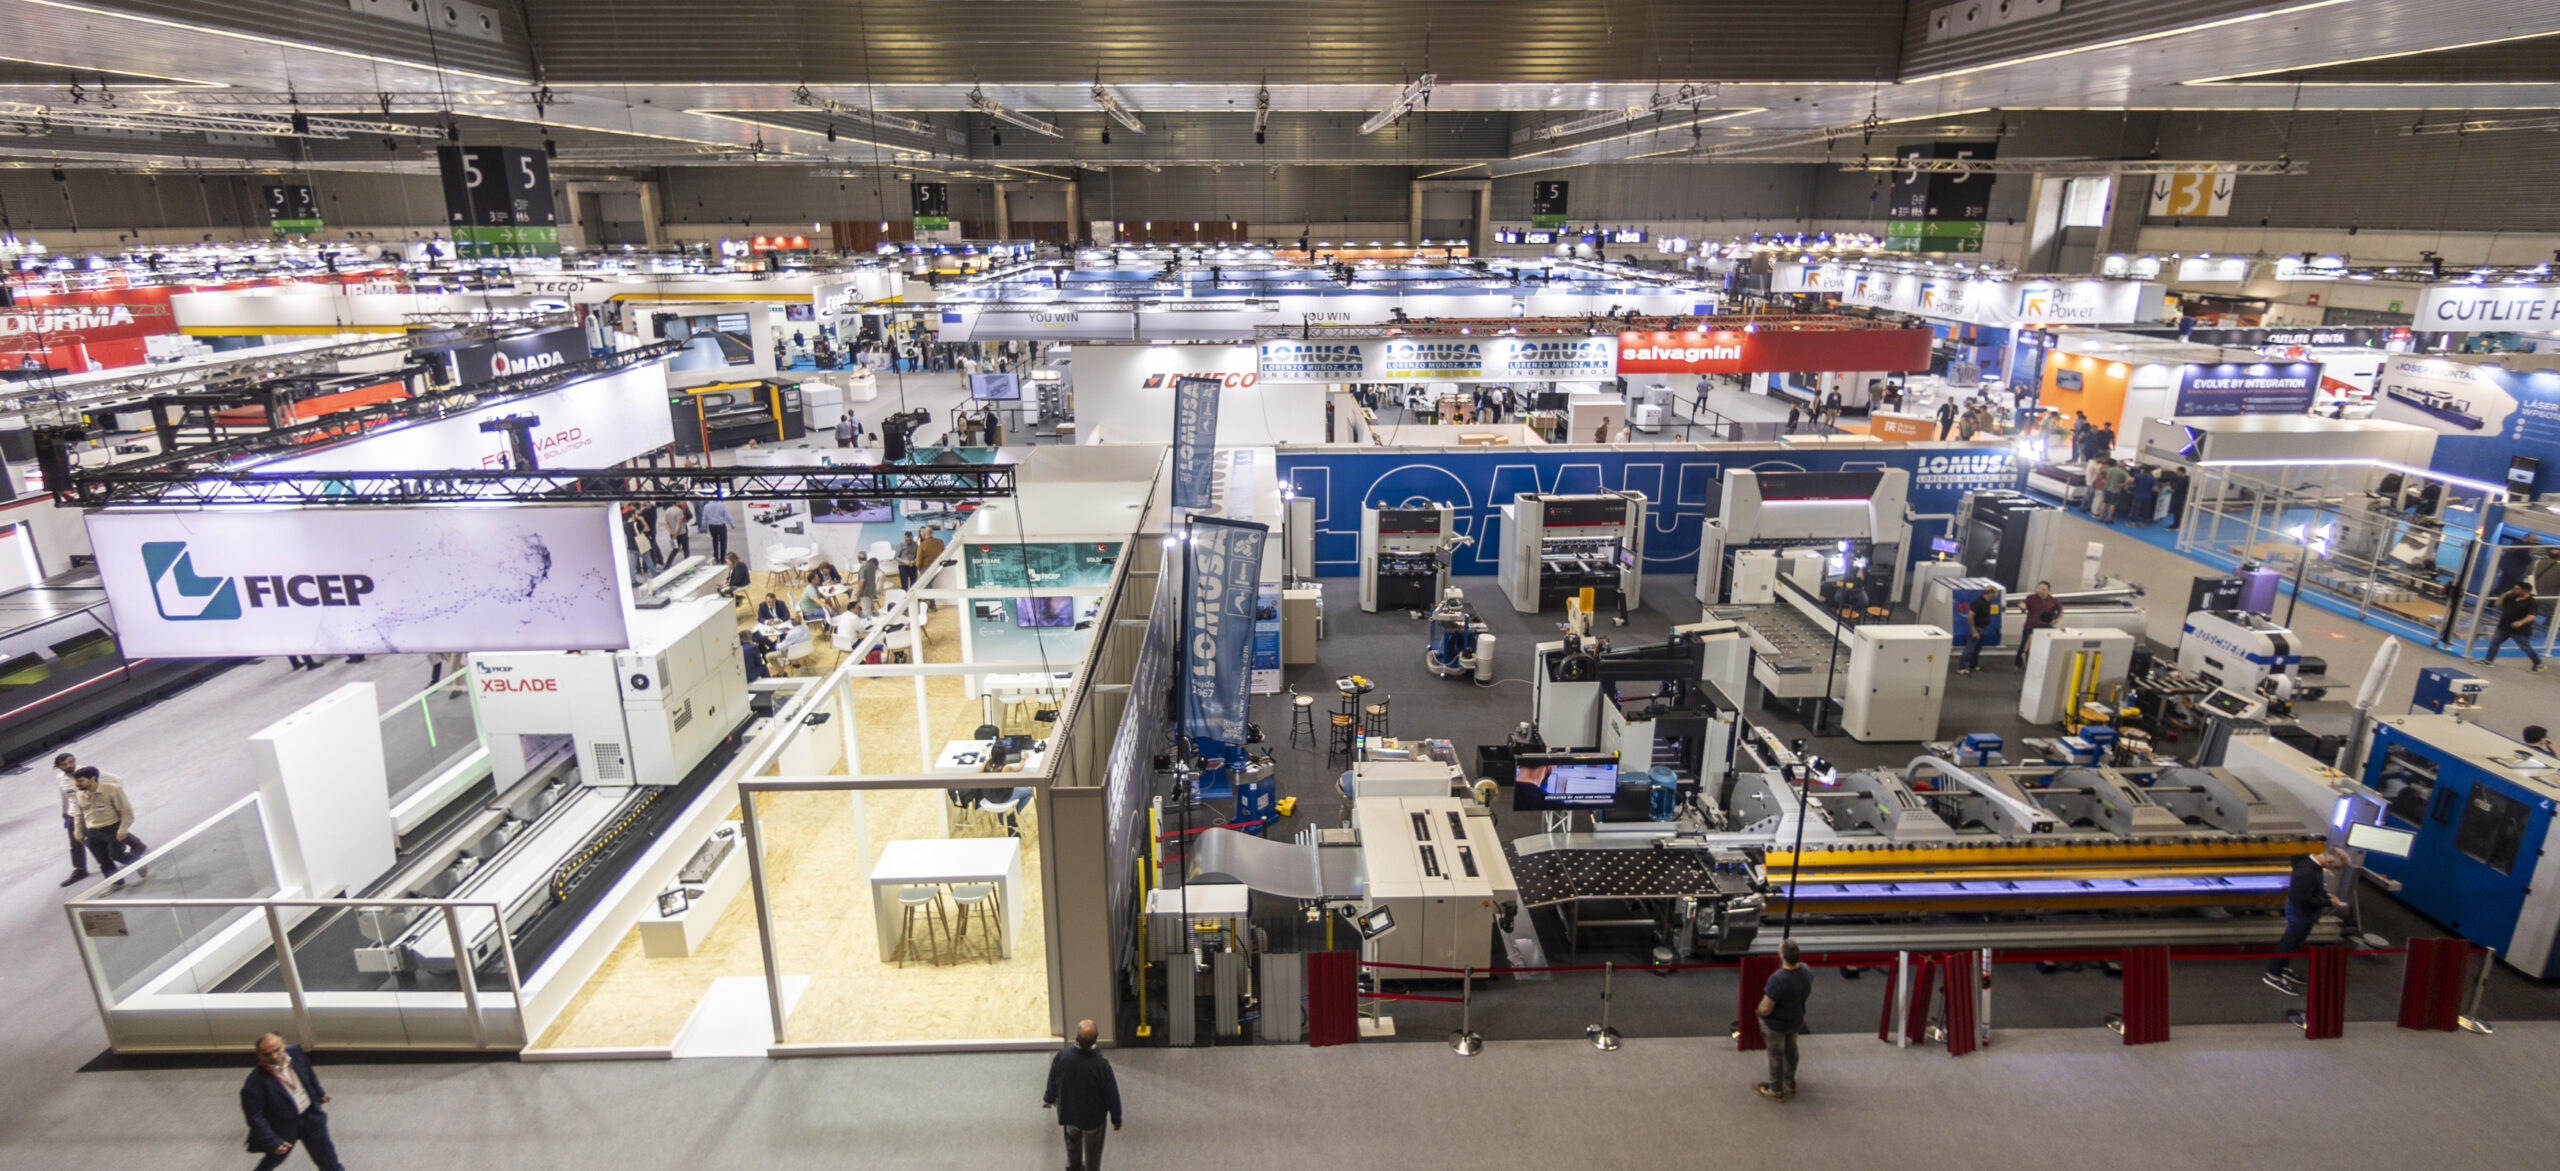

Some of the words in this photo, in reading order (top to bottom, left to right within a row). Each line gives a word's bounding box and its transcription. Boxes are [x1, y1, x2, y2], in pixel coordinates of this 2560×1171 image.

[463, 154, 483, 188] 5
[520, 156, 535, 189] 5
[1905, 152, 1920, 185] 5
[1952, 151, 1973, 184] 5
[273, 188, 284, 204] 5
[300, 188, 310, 204] 5
[921, 186, 930, 201] 5
[1550, 184, 1559, 199] 5
[2176, 165, 2205, 214] 3
[1029, 314, 1052, 322] YOU
[1056, 313, 1079, 322] WIN
[1301, 312, 1325, 321] YOU
[1327, 312, 1351, 321] WIN
[2050, 303, 2095, 318] Power
[2437, 300, 2546, 321] CUTLITE
[0, 303, 135, 337] DURMA
[2268, 333, 2309, 343] CUTLITE
[2312, 333, 2345, 343] PENTA
[1262, 345, 1362, 362] LOMUSA
[1387, 344, 1482, 360] LOMUSA
[1509, 343, 1608, 360] LOMUSA
[1622, 345, 1741, 363] salvagnini
[491, 351, 565, 377] AMADA
[1168, 372, 1257, 388] DCO
[2193, 379, 2232, 389] EVOLVE
[2232, 379, 2244, 388] BY
[2244, 378, 2306, 388] INTEGRATION
[1179, 383, 1200, 471] LOMUSA
[1918, 455, 2018, 474] LOMUSA
[243, 574, 375, 607] FICEP
[1192, 528, 1228, 677] LOMUSA
